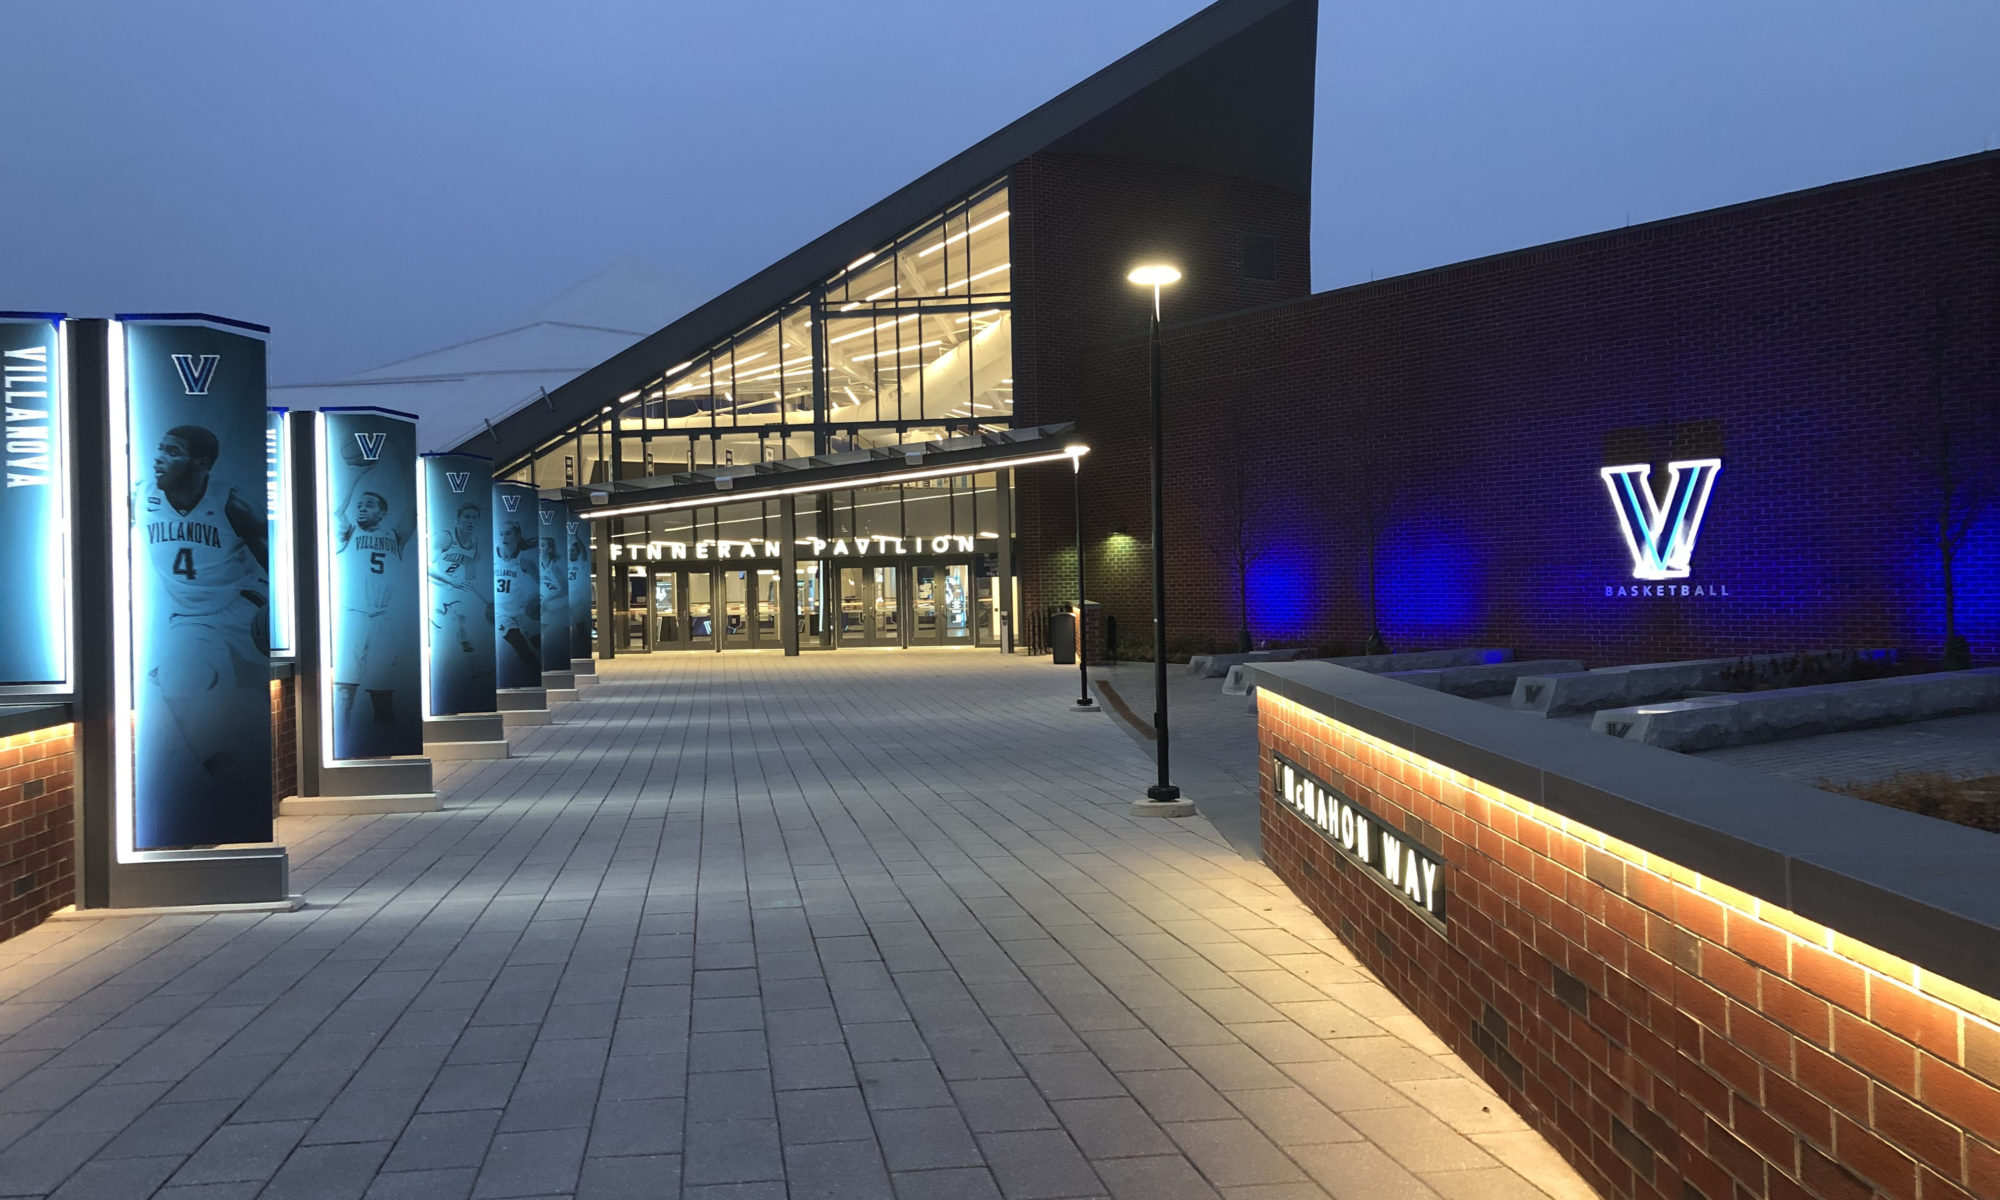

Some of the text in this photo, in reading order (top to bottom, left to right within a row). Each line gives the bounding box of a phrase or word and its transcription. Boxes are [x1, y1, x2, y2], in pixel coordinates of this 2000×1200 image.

[171, 354, 220, 395] V
[4, 345, 50, 488] VILLANOVA
[355, 432, 387, 461] V
[446, 472, 470, 493] V
[1600, 458, 1722, 580] V
[147, 521, 222, 549] VILLANOVA
[609, 535, 975, 561] FINNERAN PAVILION
[172, 546, 197, 581] 4
[370, 551, 386, 575] 5
[496, 578, 512, 594] 31
[1604, 584, 1730, 598] BASKETBALL
[1282, 764, 1370, 864] McMAHON
[1382, 831, 1437, 913] WAY
